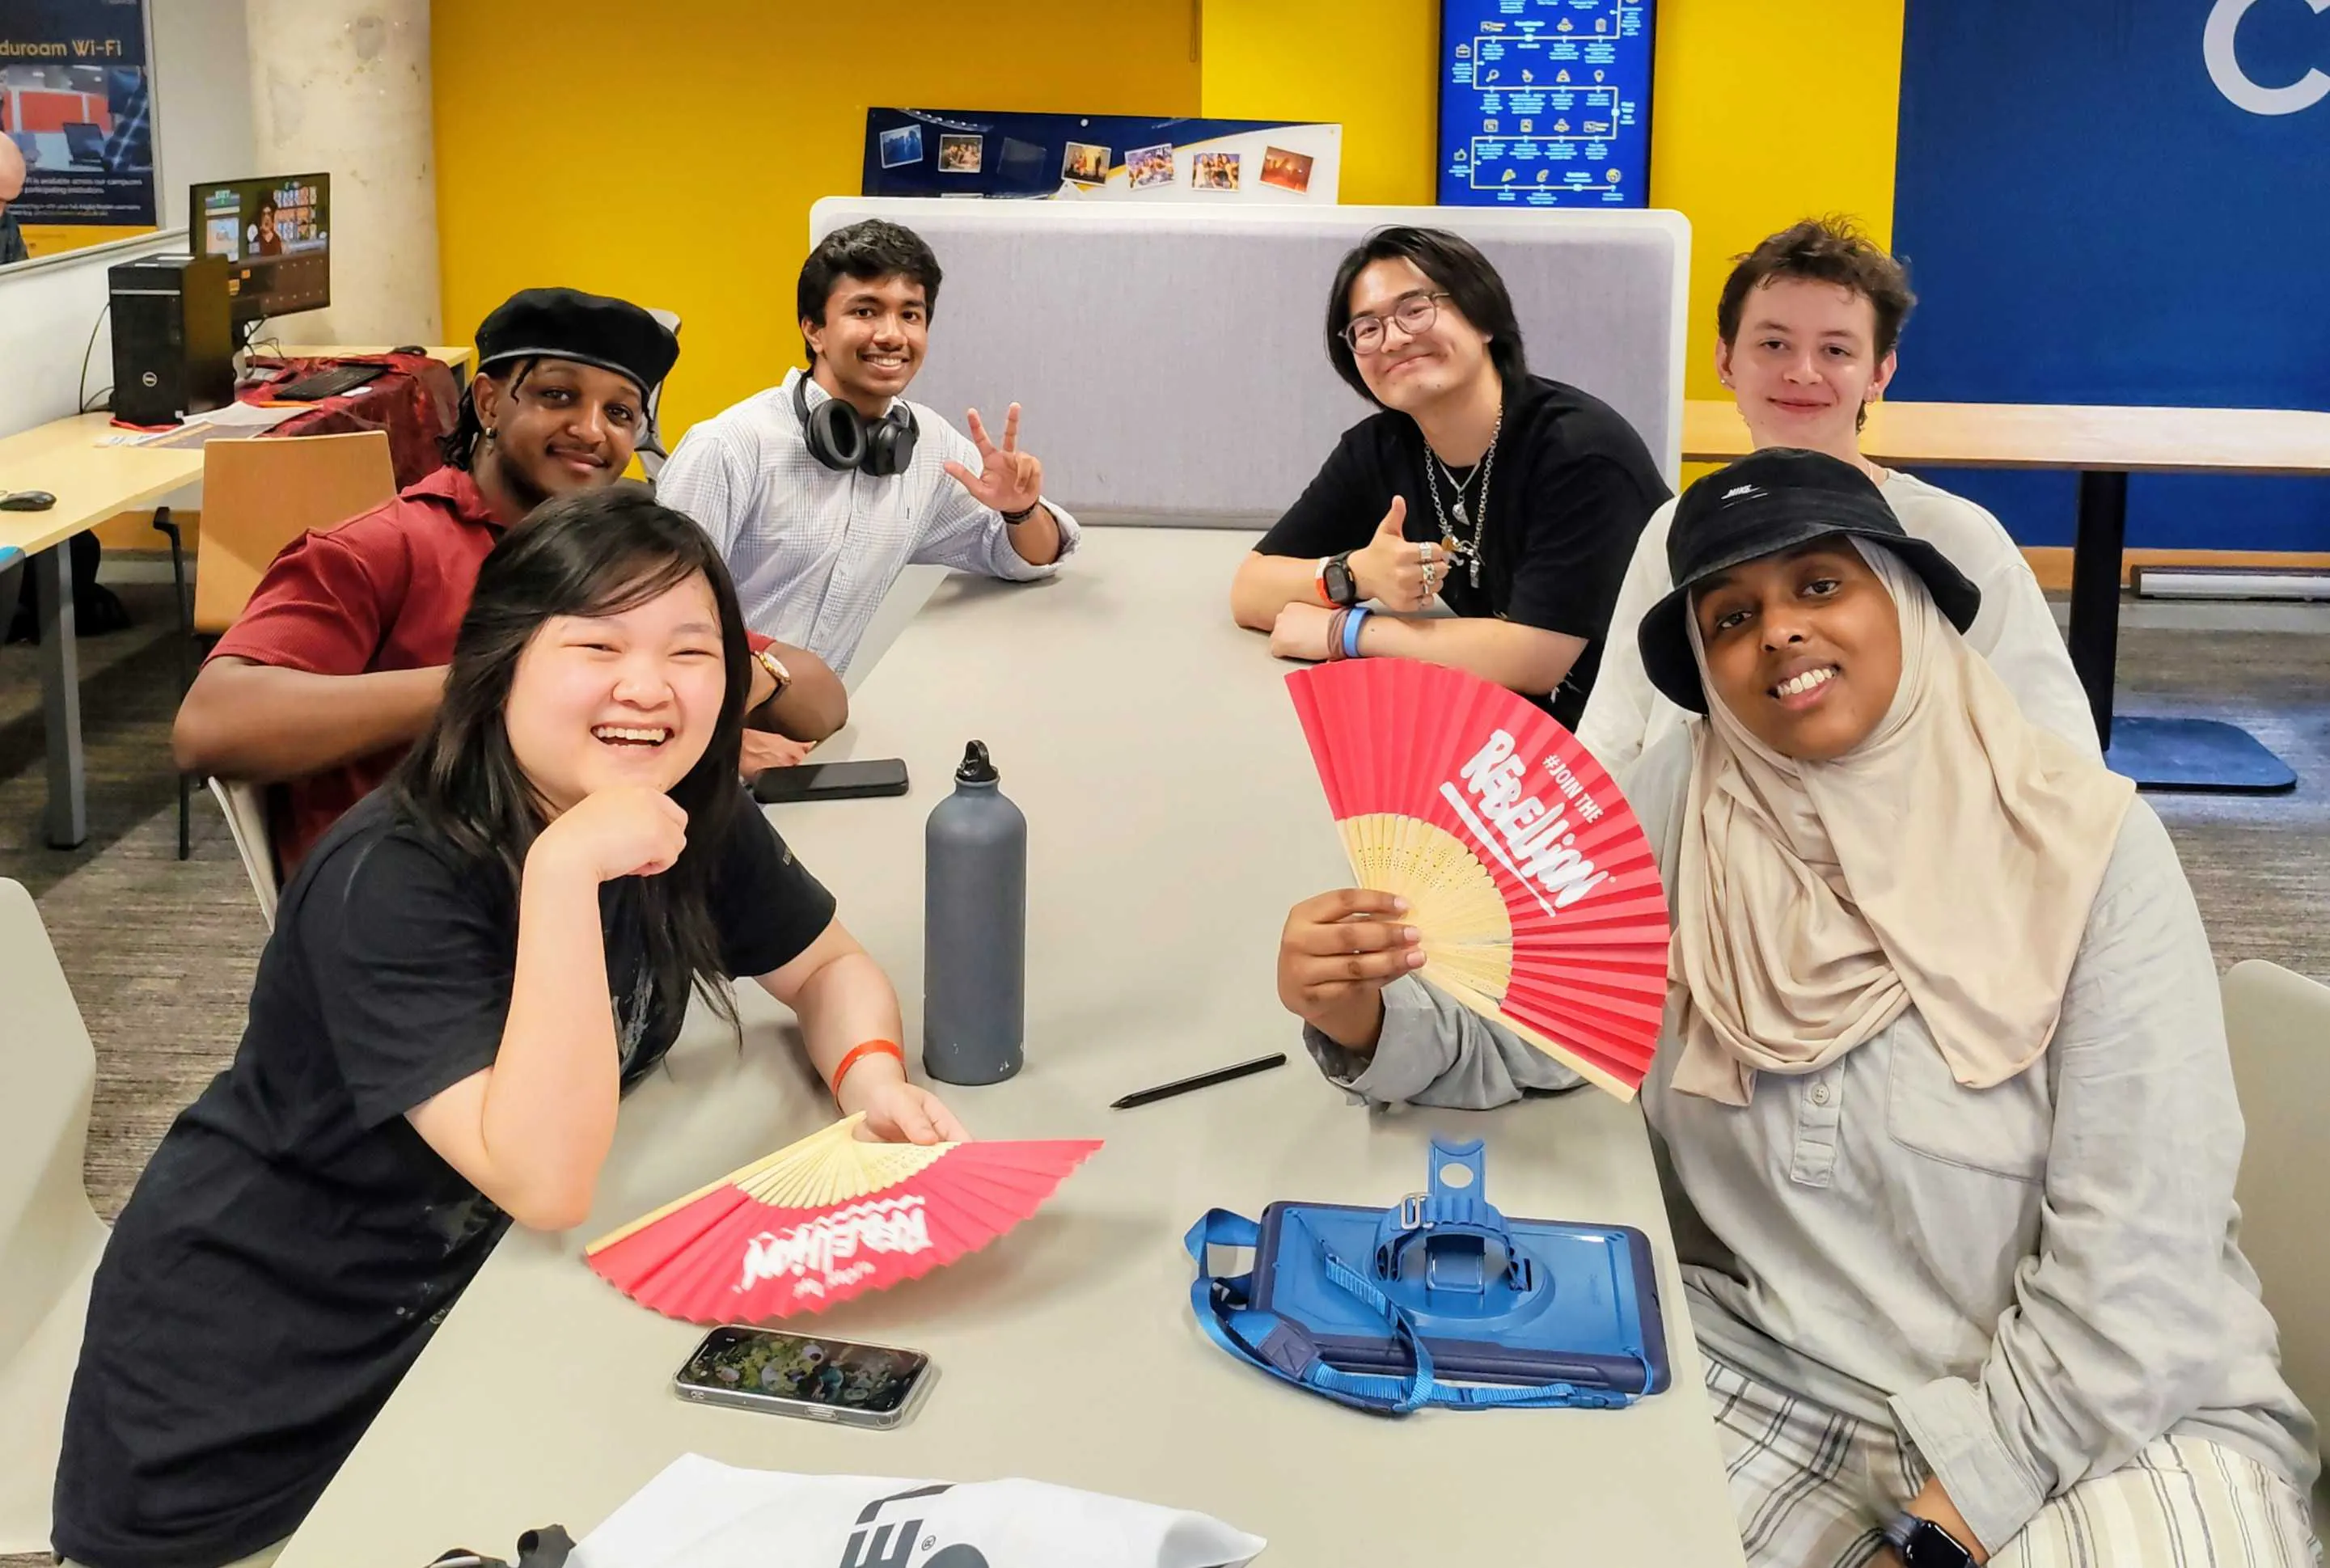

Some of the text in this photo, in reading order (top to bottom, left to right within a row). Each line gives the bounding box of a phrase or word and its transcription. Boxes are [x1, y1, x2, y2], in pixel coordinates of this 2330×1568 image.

[72, 39, 122, 57] Wi-Fi
[1721, 484, 1760, 498] NIKE
[1542, 754, 1604, 824] #JOIN THE
